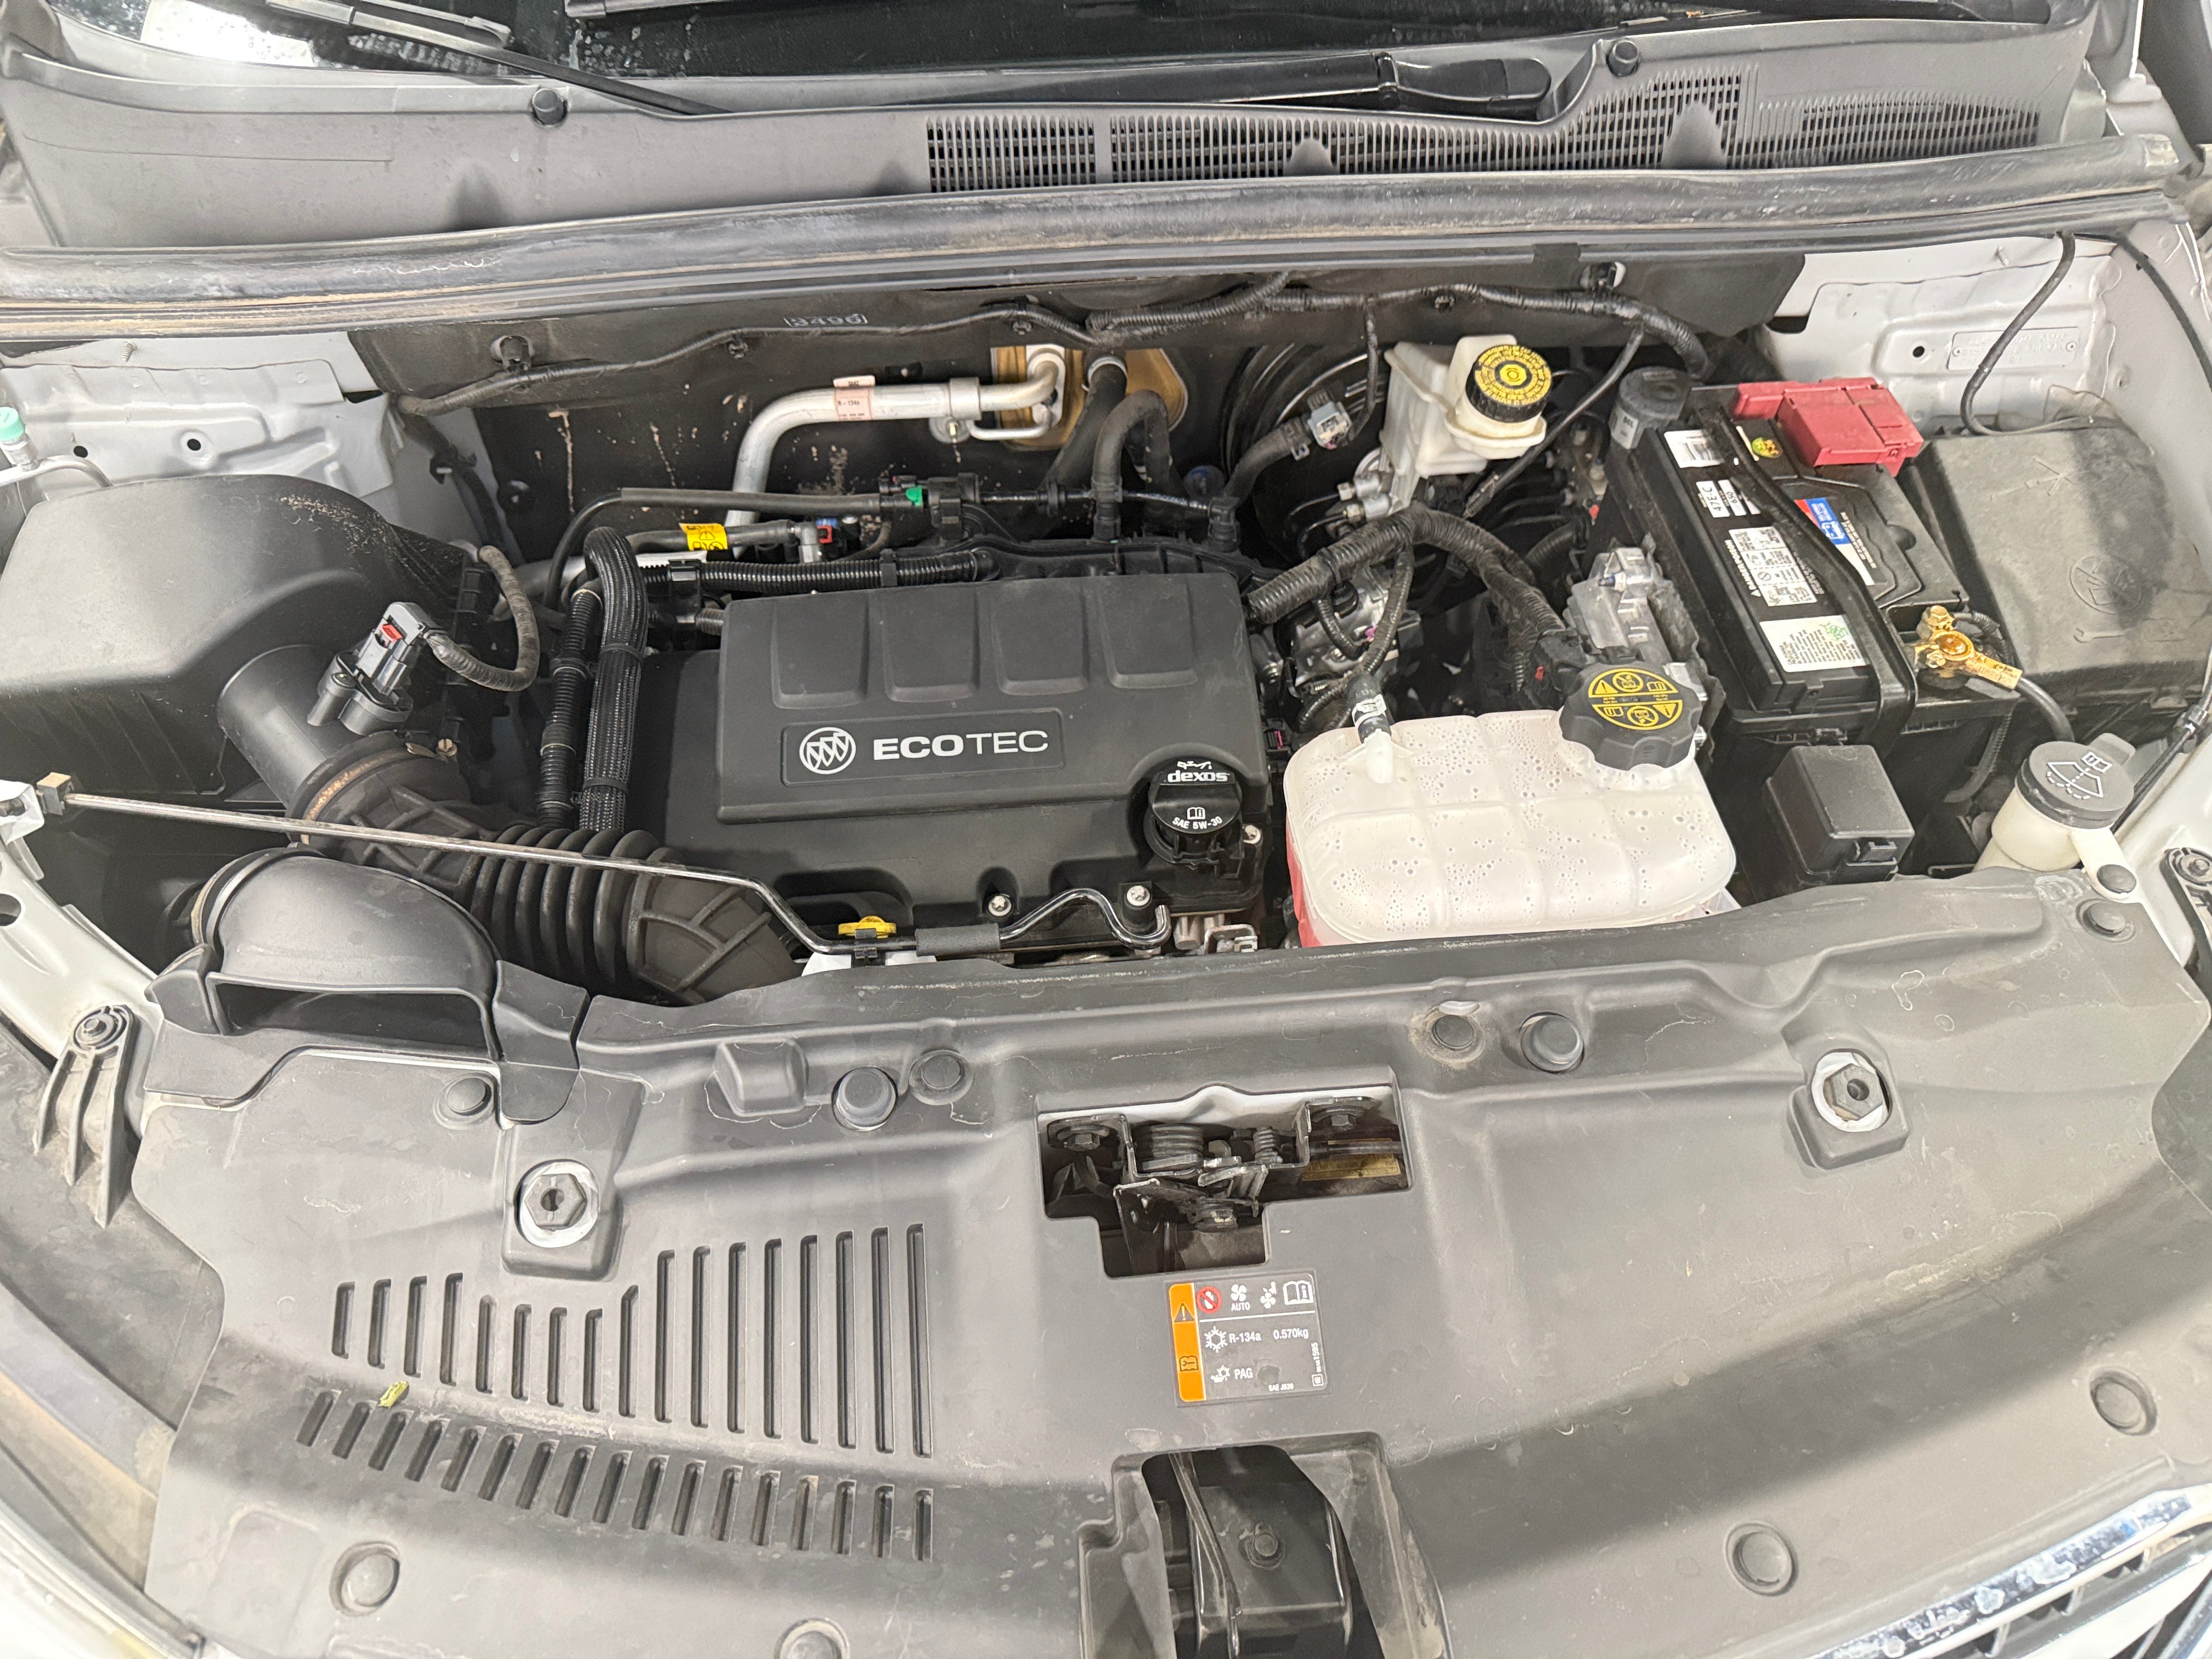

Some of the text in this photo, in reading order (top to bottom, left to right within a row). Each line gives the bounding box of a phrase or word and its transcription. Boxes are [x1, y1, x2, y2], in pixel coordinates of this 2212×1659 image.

[873, 730, 1048, 760] ECOTEC
[1167, 770, 1228, 783] dexos
[1172, 816, 1223, 830] SAE 5W-30
[1231, 1302, 1251, 1311] AUTO
[1228, 1328, 1309, 1344] R-134a 0.570kg
[1234, 1368, 1254, 1380] PAG
